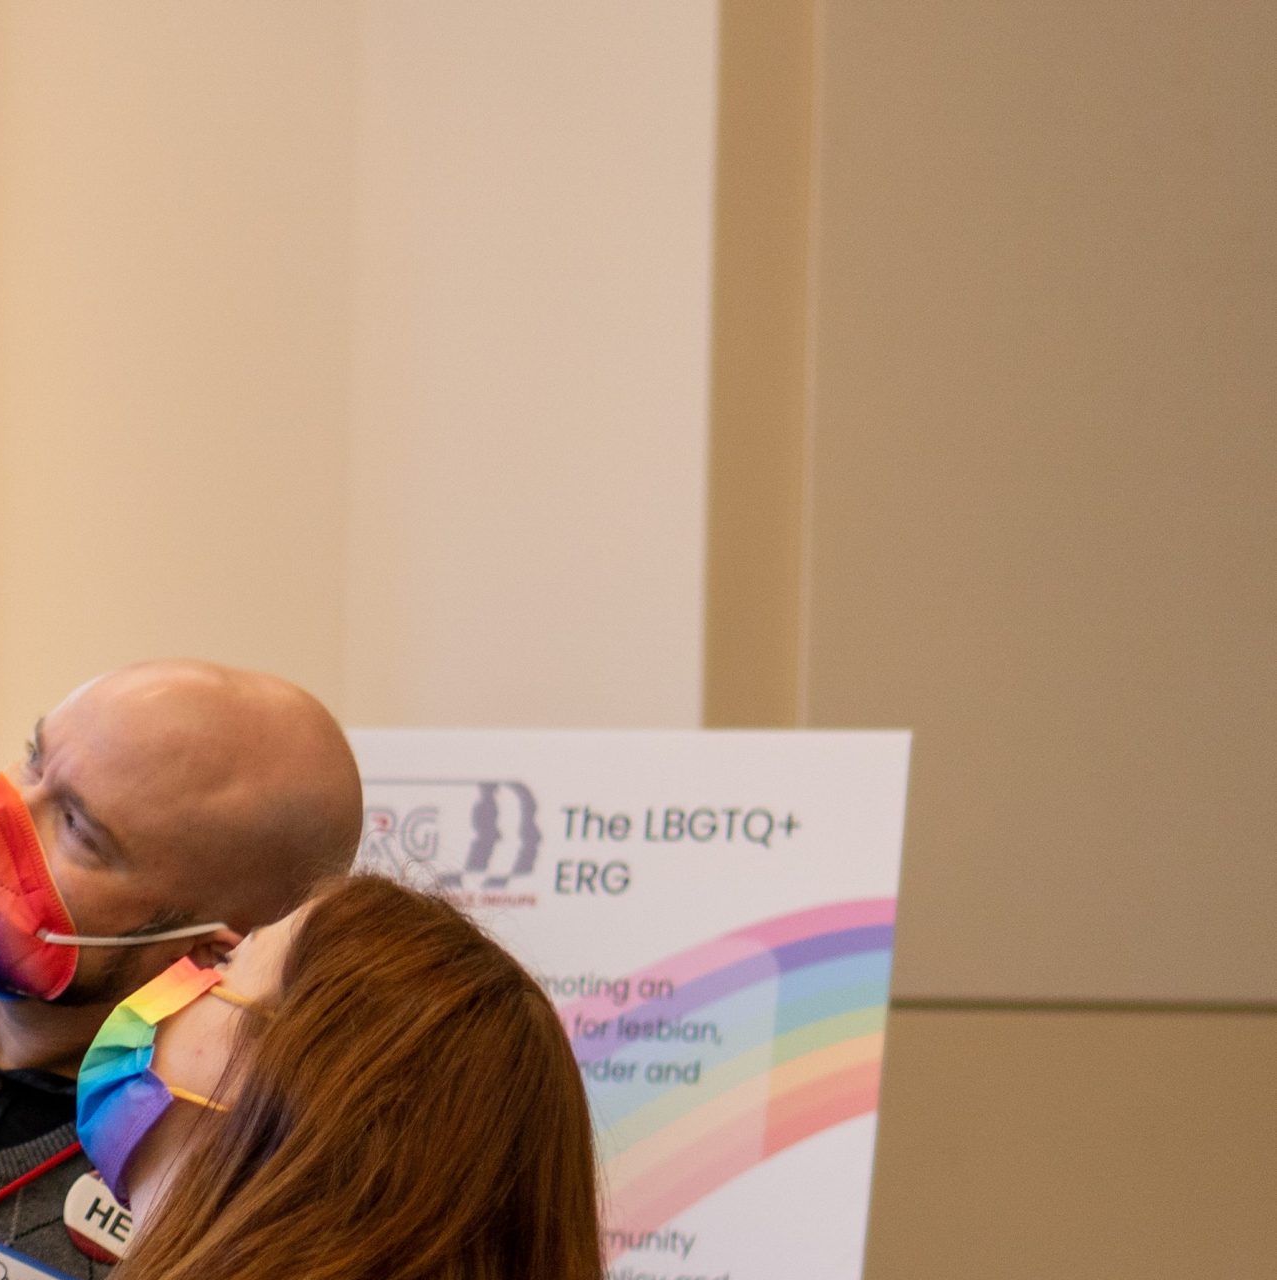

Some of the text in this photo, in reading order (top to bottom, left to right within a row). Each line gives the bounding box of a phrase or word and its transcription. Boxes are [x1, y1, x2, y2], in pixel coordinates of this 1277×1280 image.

[562, 806, 800, 849] The LBGTQ+
[554, 860, 631, 895] ERG
[638, 978, 673, 997] an
[574, 1014, 721, 1046] for lesbian,
[645, 1060, 700, 1084] and
[84, 1197, 132, 1242] HE
